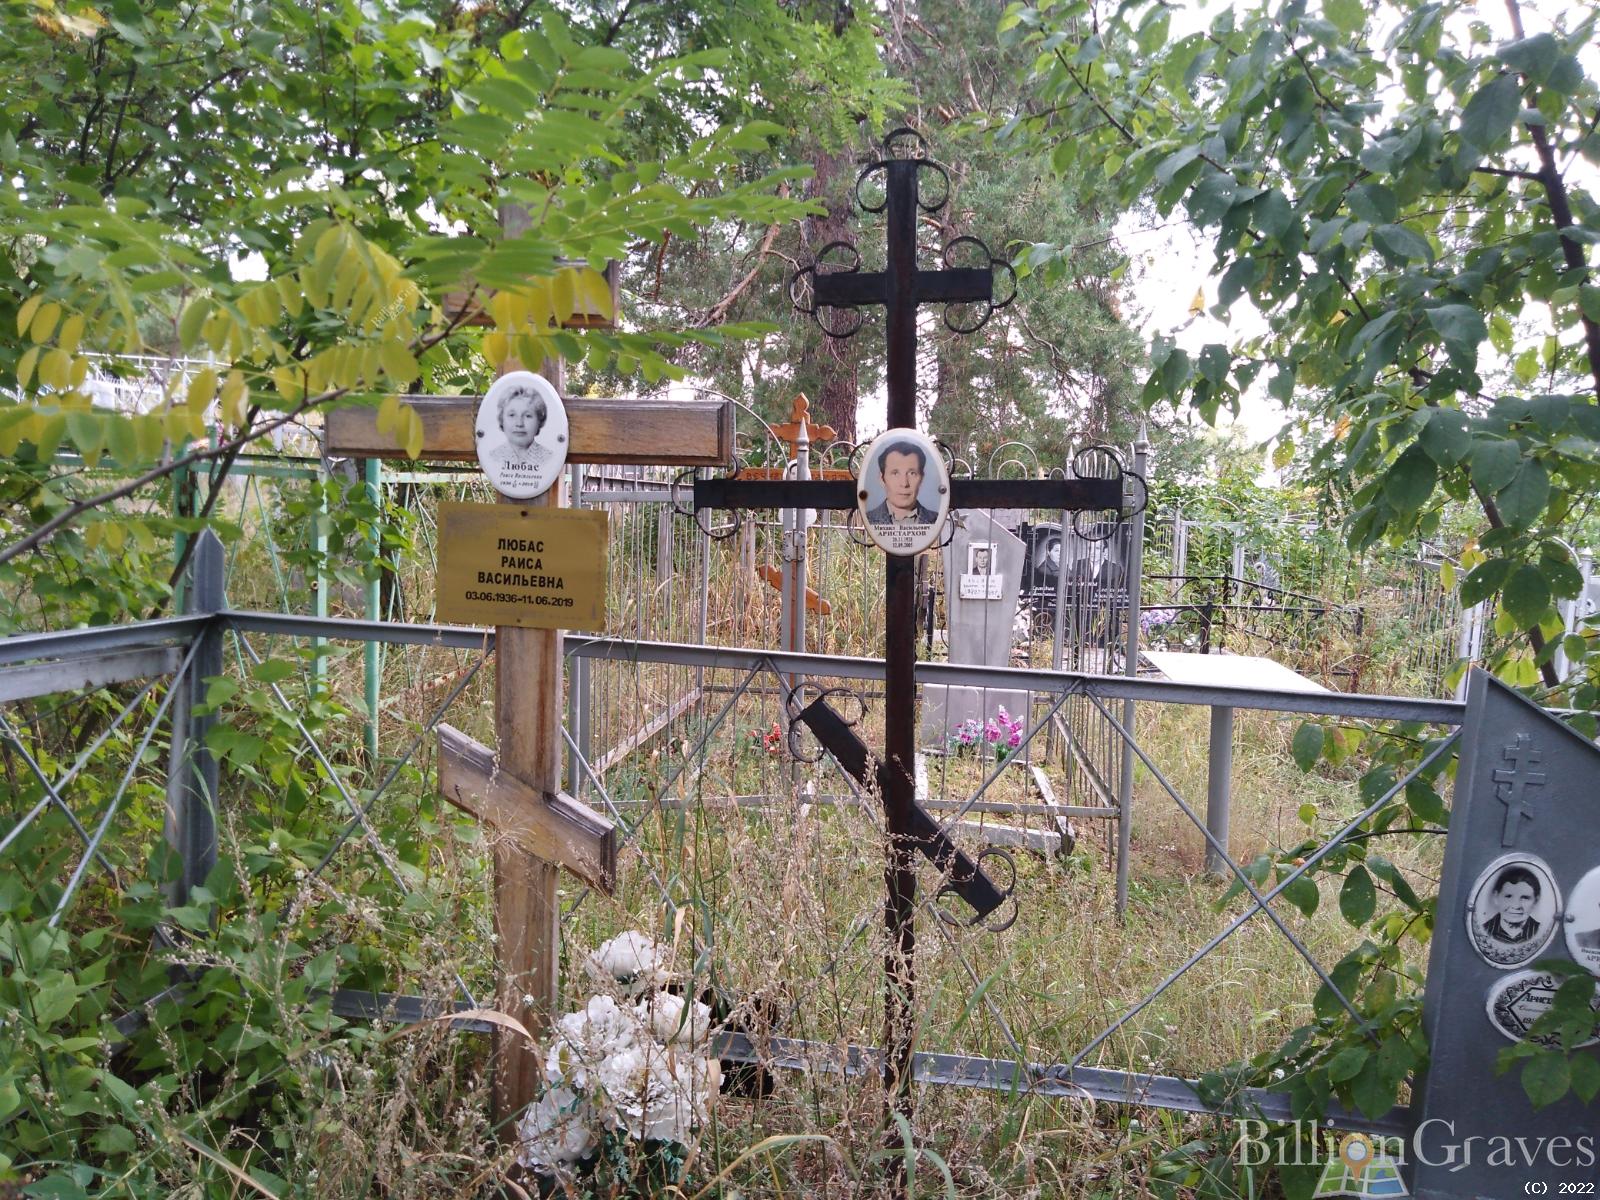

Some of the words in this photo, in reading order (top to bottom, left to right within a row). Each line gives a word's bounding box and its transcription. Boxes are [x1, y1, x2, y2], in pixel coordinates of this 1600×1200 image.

[501, 460, 540, 471] Любас
[497, 538, 544, 552] ЛЮБАС
[501, 556, 543, 570] РАИСА
[478, 572, 564, 589] ВАСИЛЬЕВНА
[465, 591, 574, 607] 03.06.1936-11.06.2019
